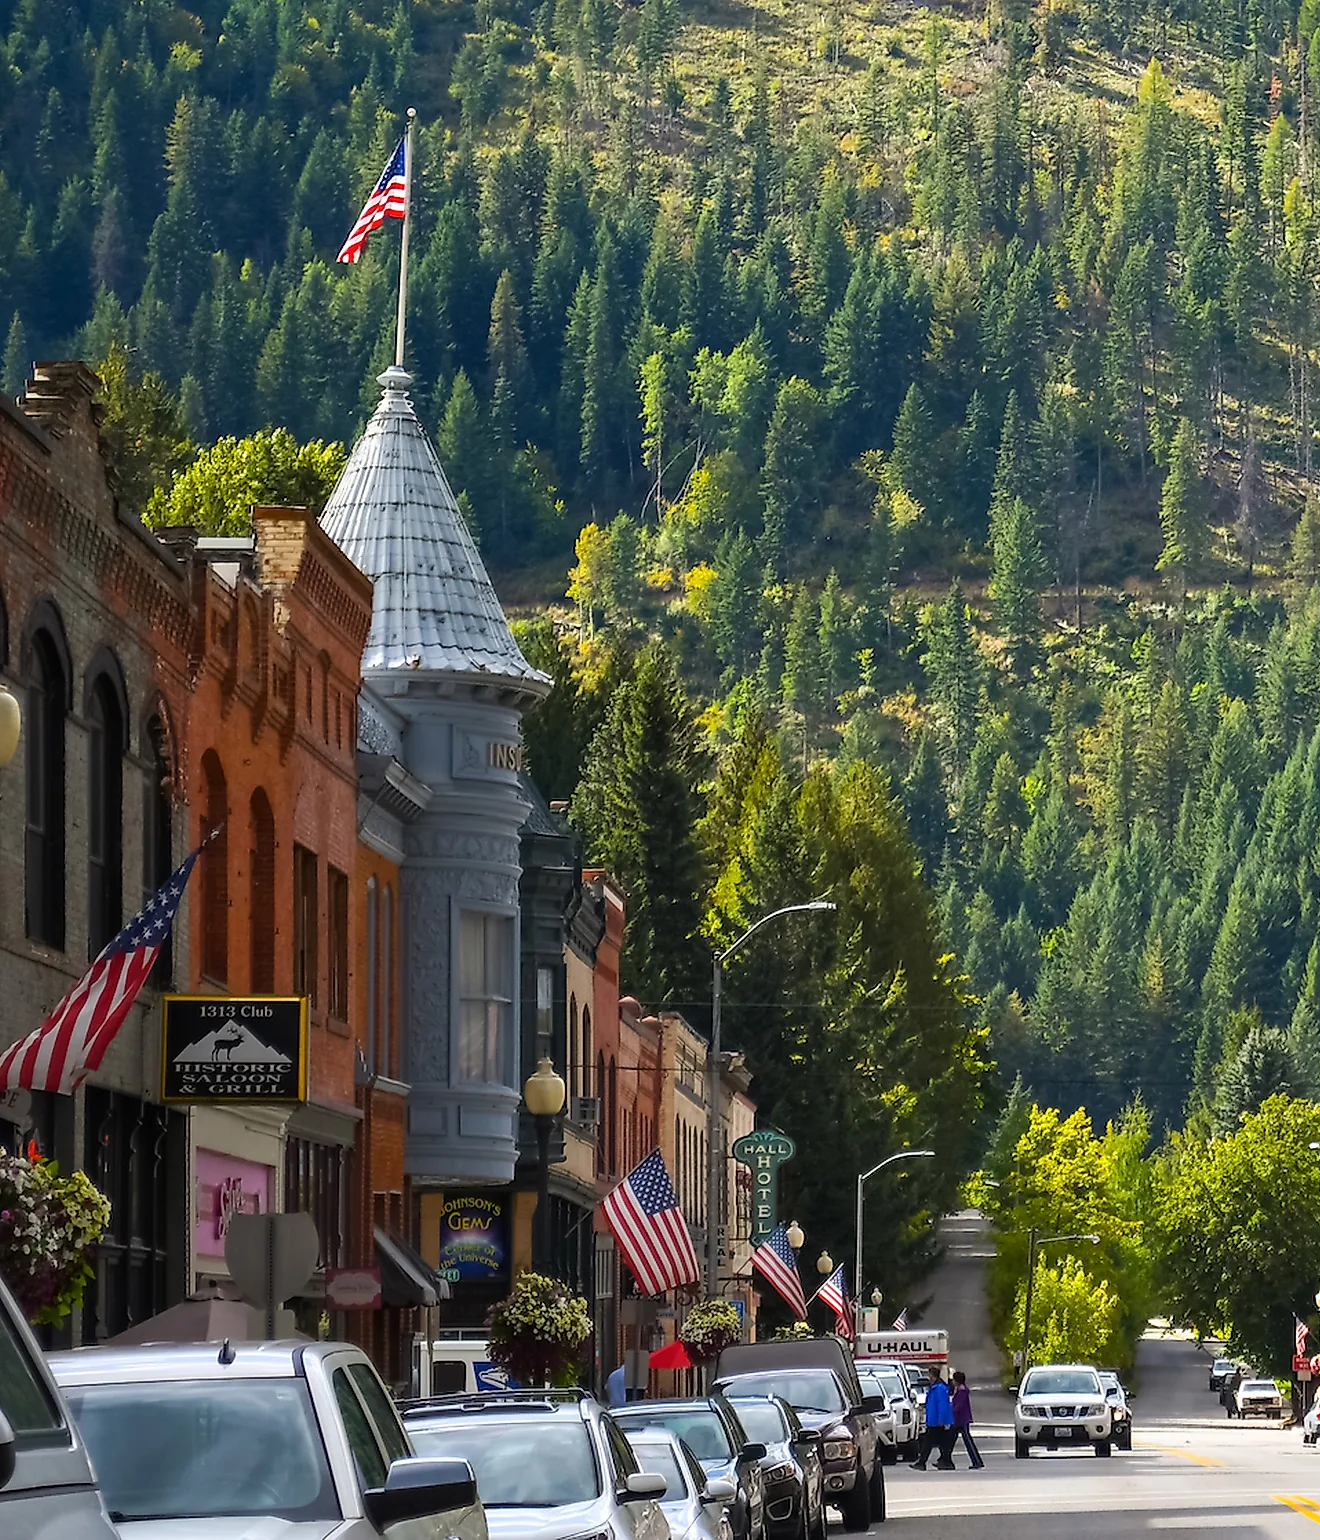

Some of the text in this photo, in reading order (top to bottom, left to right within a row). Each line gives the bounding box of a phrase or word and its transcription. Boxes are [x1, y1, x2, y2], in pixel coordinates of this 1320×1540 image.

[200, 1005, 273, 1018] 1313 Club
[175, 1063, 292, 1073] HISTORIC
[182, 1074, 282, 1083] SALOON
[179, 1084, 286, 1094] & GRILL
[744, 1144, 787, 1155] HALL
[757, 1155, 772, 1234] HOTEL
[458, 1251, 499, 1271] Universe
[867, 1341, 933, 1353] U-HAUL
